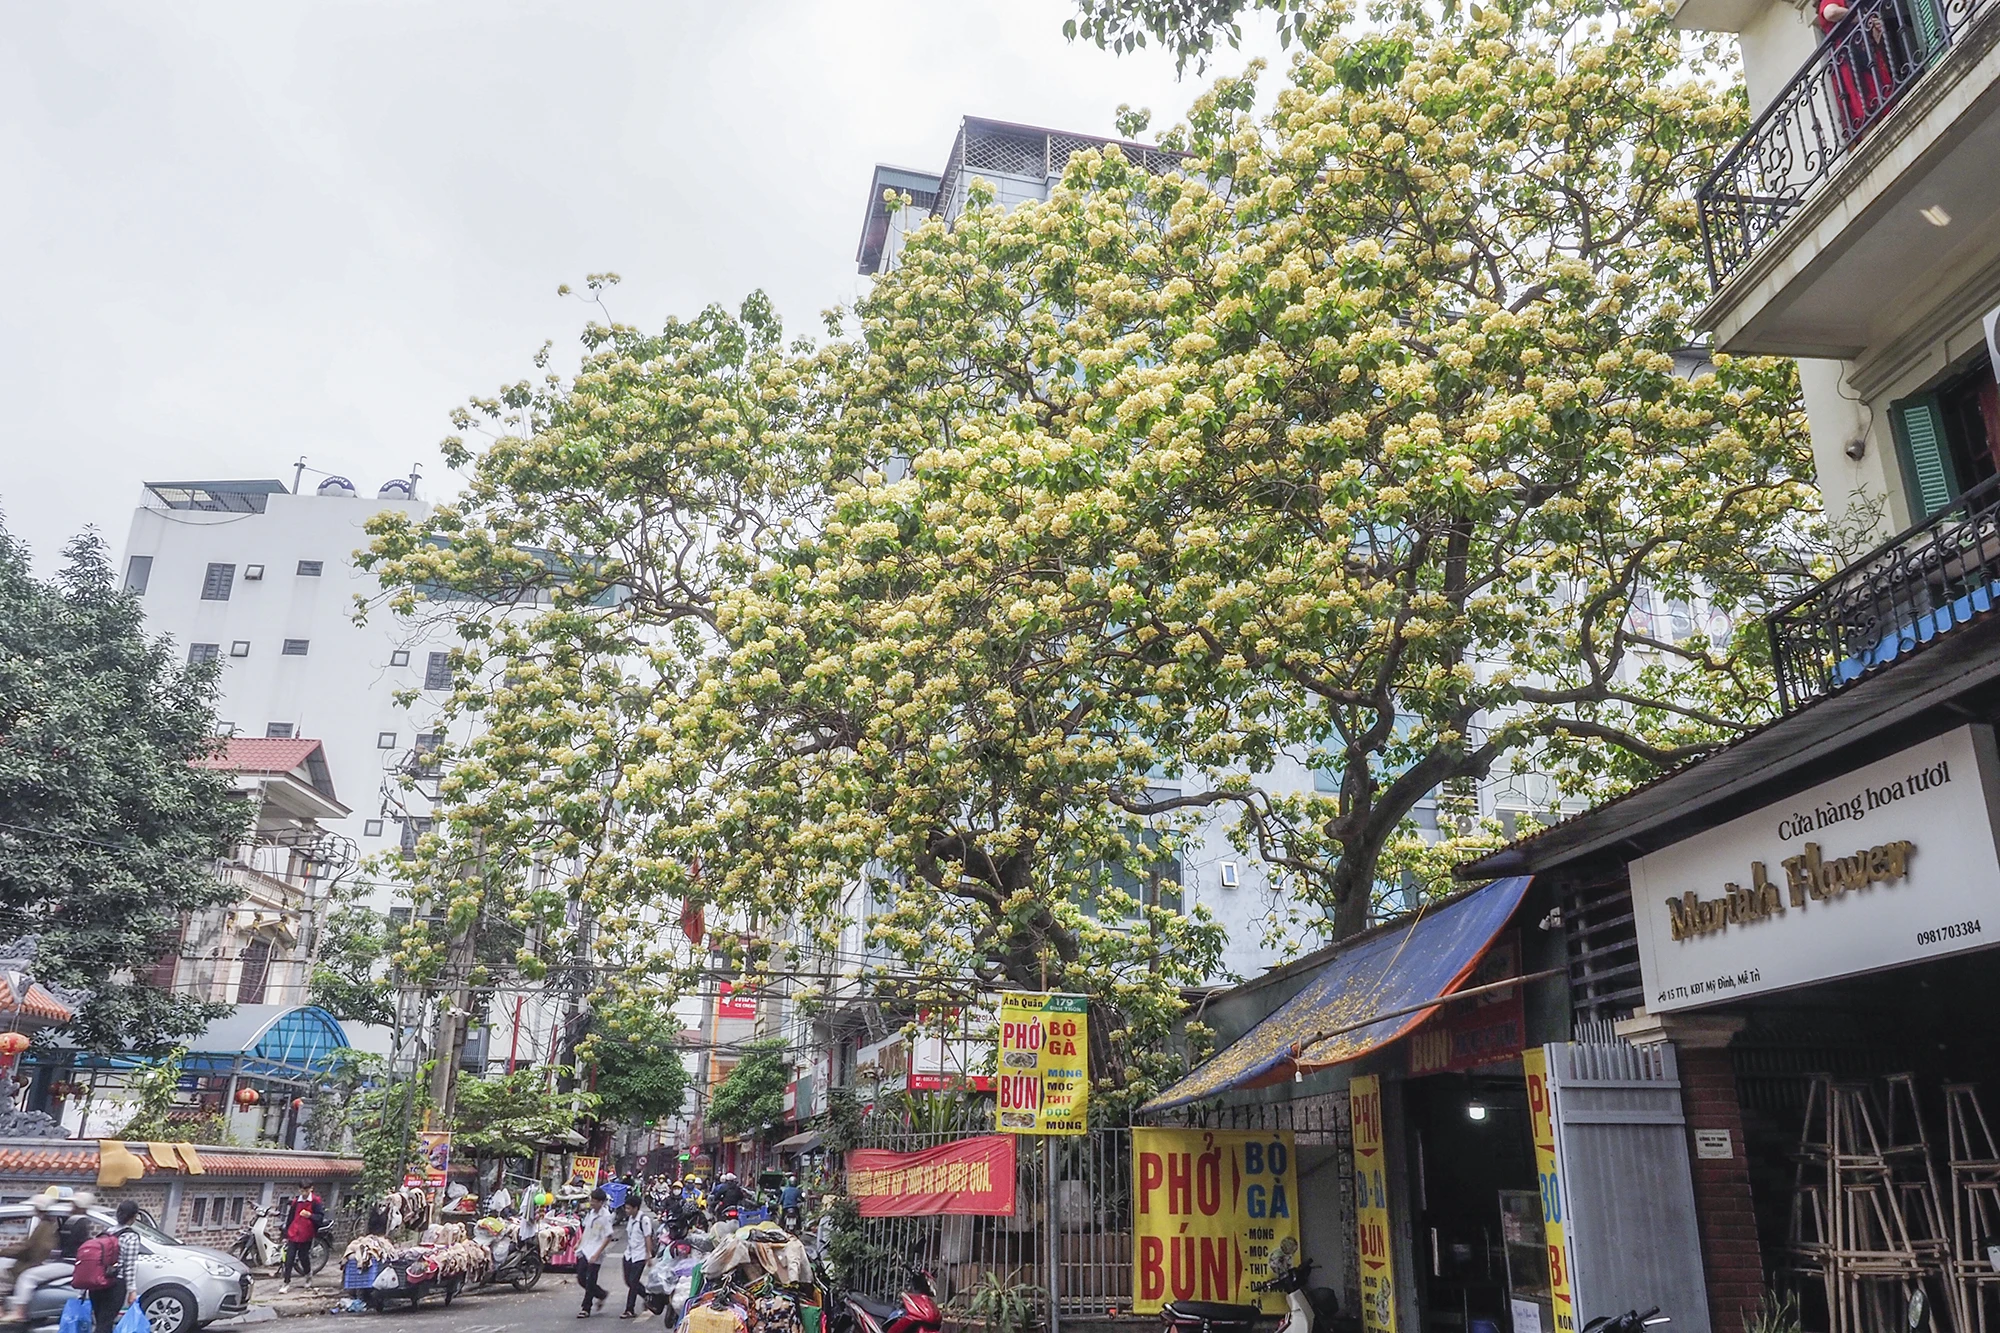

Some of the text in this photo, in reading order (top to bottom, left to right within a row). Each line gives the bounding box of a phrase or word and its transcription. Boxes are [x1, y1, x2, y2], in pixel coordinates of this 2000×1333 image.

[1778, 760, 1952, 841] Cửa hàng hoa tươi
[1666, 840, 1915, 941] Moriah Flower
[1916, 919, 1982, 946] 0981703384
[1668, 989, 1675, 1000] 15
[1690, 982, 1705, 995] KĐT
[1749, 968, 1761, 982] Trì
[1055, 998, 1074, 1007] 179
[1003, 1015, 1041, 1050] PHỞ
[1049, 1019, 1077, 1037] BÒ
[1049, 1038, 1077, 1056] GÀ
[1000, 1069, 1038, 1110] BÚN
[1047, 1067, 1083, 1078] MÓNG
[1047, 1081, 1074, 1092] MỌC
[1046, 1094, 1072, 1105] THỊT
[1352, 1074, 1380, 1143] PHỞ
[1046, 1119, 1082, 1130] MÙNG
[1245, 1133, 1287, 1175] BÒ
[1139, 1132, 1222, 1216] PHỞ
[1246, 1177, 1290, 1219] GÀ
[1360, 1217, 1386, 1258] BÚN
[1140, 1222, 1229, 1301] BÚN
